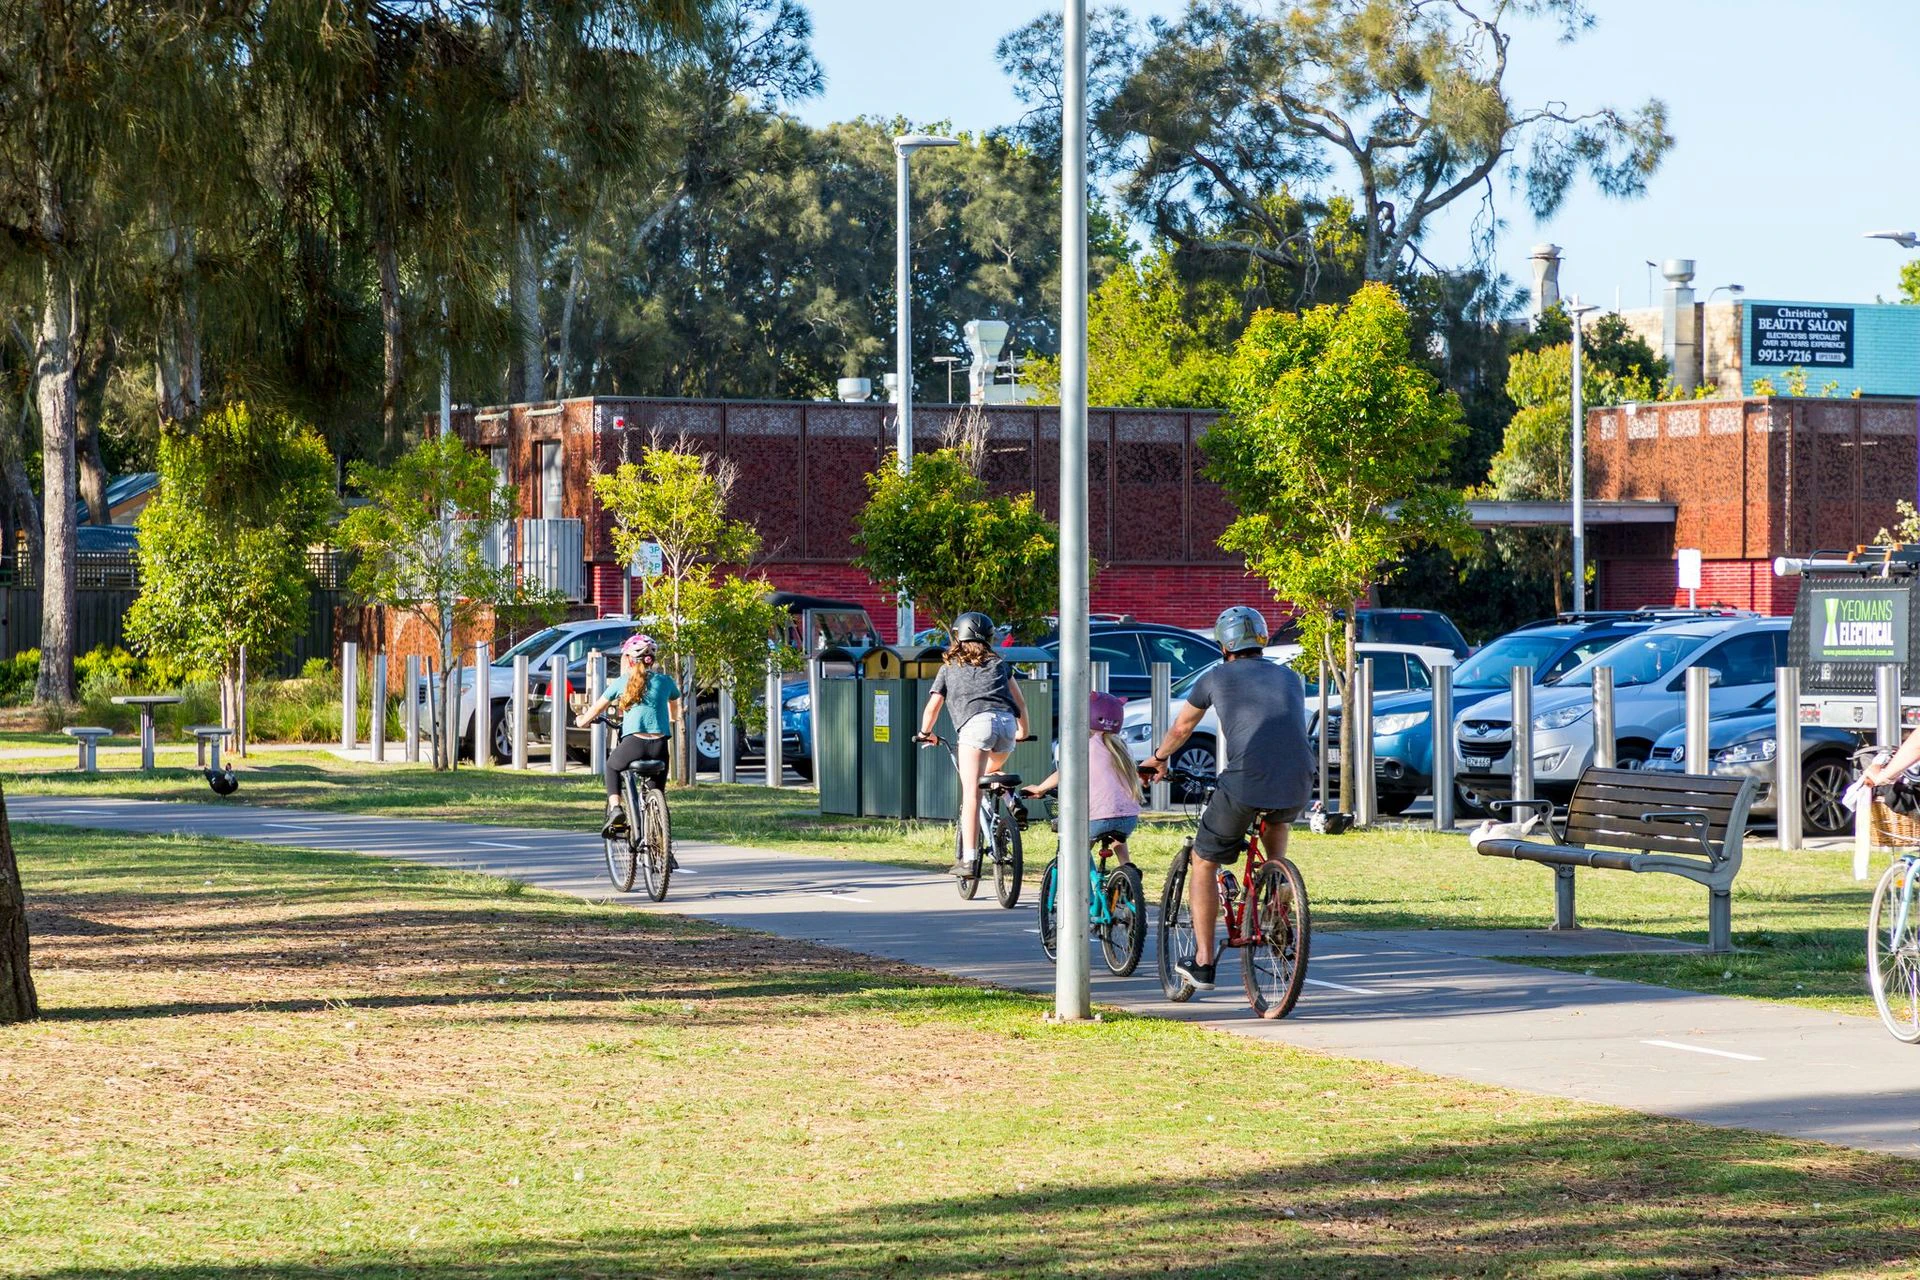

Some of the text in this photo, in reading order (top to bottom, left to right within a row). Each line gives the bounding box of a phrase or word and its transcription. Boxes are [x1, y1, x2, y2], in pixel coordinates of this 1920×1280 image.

[1777, 308, 1828, 319] Christine's
[1758, 318, 1847, 332] BEAUTY SALON
[1766, 332, 1841, 341] ELECTROLYSIS SPECIALIST
[1758, 349, 1811, 362] 9913-7216
[1840, 600, 1893, 621] YEOMANS
[1840, 622, 1894, 646] ELECTRICAL
